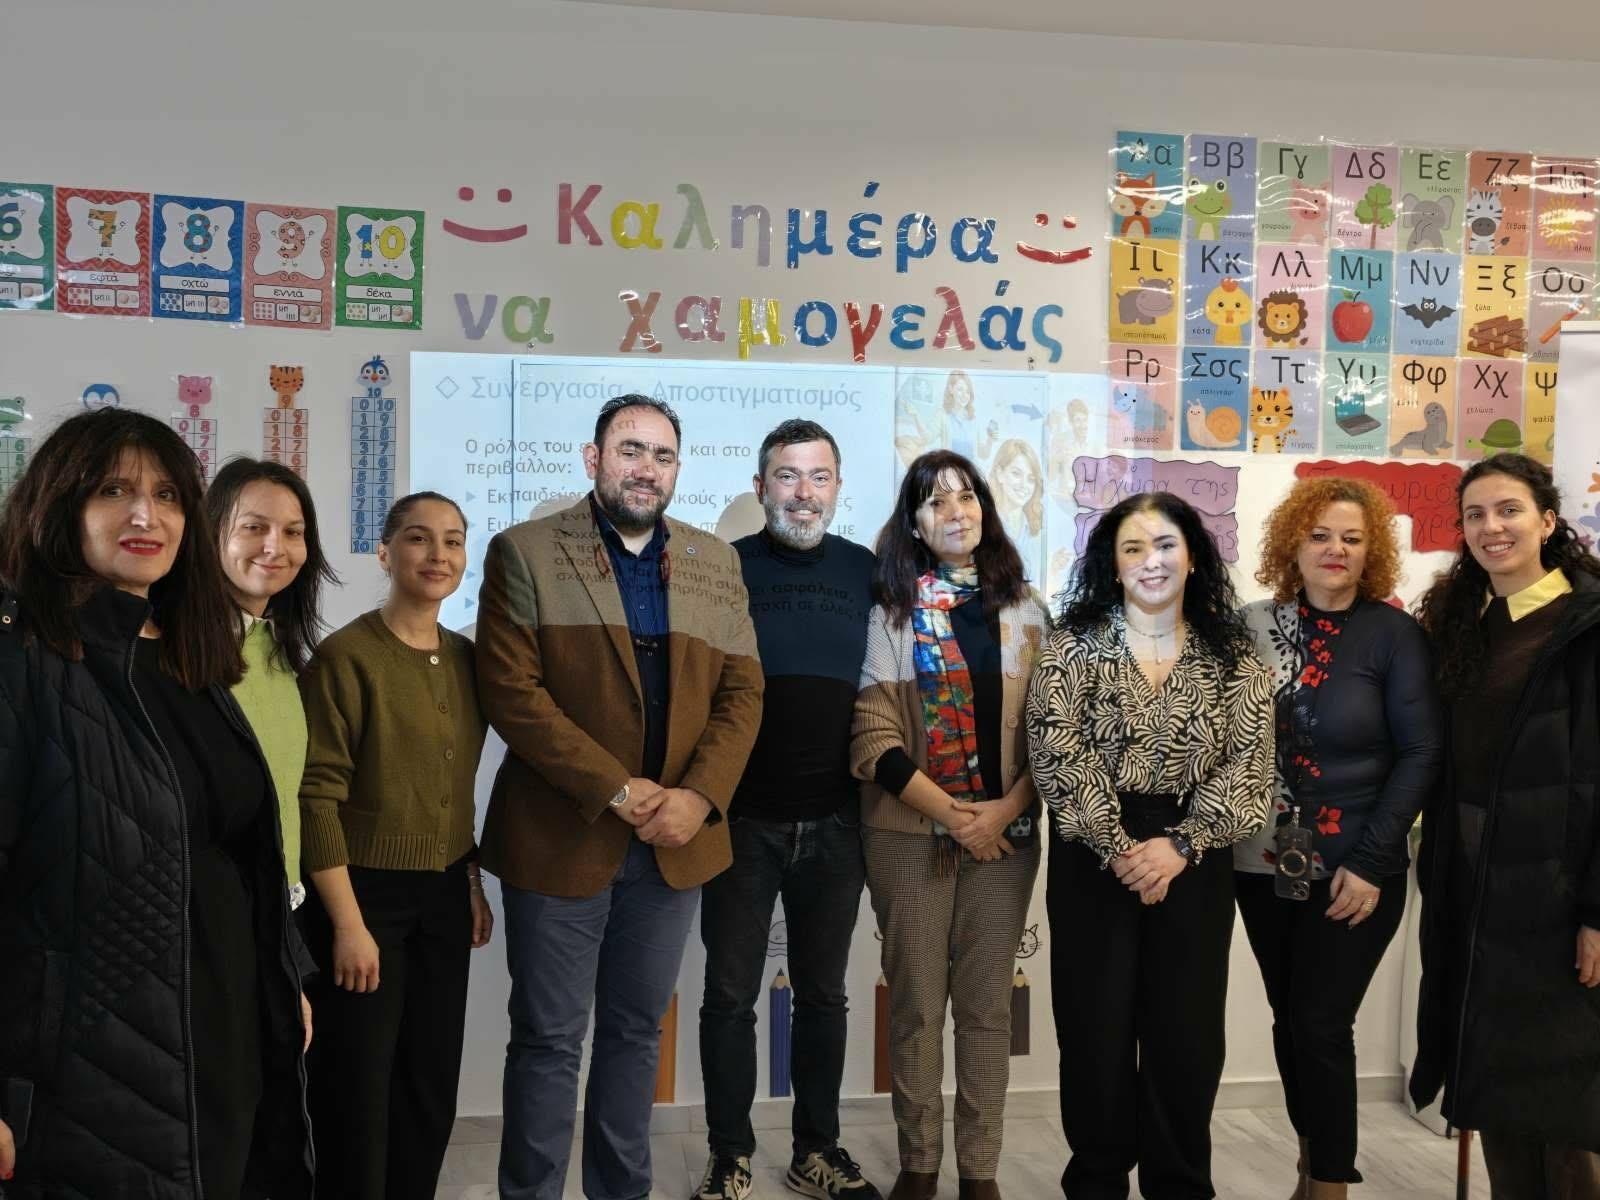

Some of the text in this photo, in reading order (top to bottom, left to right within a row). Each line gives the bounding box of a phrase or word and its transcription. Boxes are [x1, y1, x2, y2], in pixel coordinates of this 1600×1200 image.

[1203, 141, 1245, 177] Ββ
[1278, 148, 1308, 179] Γγ
[1345, 151, 1386, 180] Δδ
[1418, 153, 1452, 181] Εε
[88, 209, 117, 248] 7
[183, 213, 213, 253] 8
[277, 221, 306, 259] 9
[558, 181, 999, 273] Καλημέρα
[356, 224, 406, 260] 10
[1201, 245, 1241, 275] Κκ
[1271, 250, 1312, 278] Λλ
[1340, 255, 1383, 289] Μμ
[1410, 259, 1450, 287] Νν
[181, 278, 209, 290] οχτώ
[273, 287, 304, 298] εννιά
[366, 287, 393, 299] δέκα
[454, 280, 1064, 362] να χαμογελάς
[1125, 349, 1161, 383] Ρρ
[1191, 352, 1242, 384] Σσς
[1271, 356, 1306, 384] Ττ
[1402, 359, 1447, 393] Φφ
[1473, 363, 1509, 399] Χχ
[359, 399, 394, 411] 0 10
[652, 379, 863, 412] Αποστιγματισμός
[179, 420, 189, 433] 0
[270, 409, 281, 422] 0
[359, 412, 390, 426] 1 9
[200, 434, 209, 448] 7
[271, 423, 280, 437] 1
[359, 426, 390, 440] 2 8
[270, 438, 281, 451] 2
[359, 441, 389, 455] 3 7
[484, 437, 537, 457] ρόλος
[543, 440, 573, 453] του
[690, 443, 716, 456] και
[723, 445, 751, 457] στο
[357, 469, 388, 482] 5 5
[358, 455, 388, 468] 4 6
[355, 511, 365, 524] 8
[353, 540, 369, 553] 10
[355, 526, 365, 540] 9
